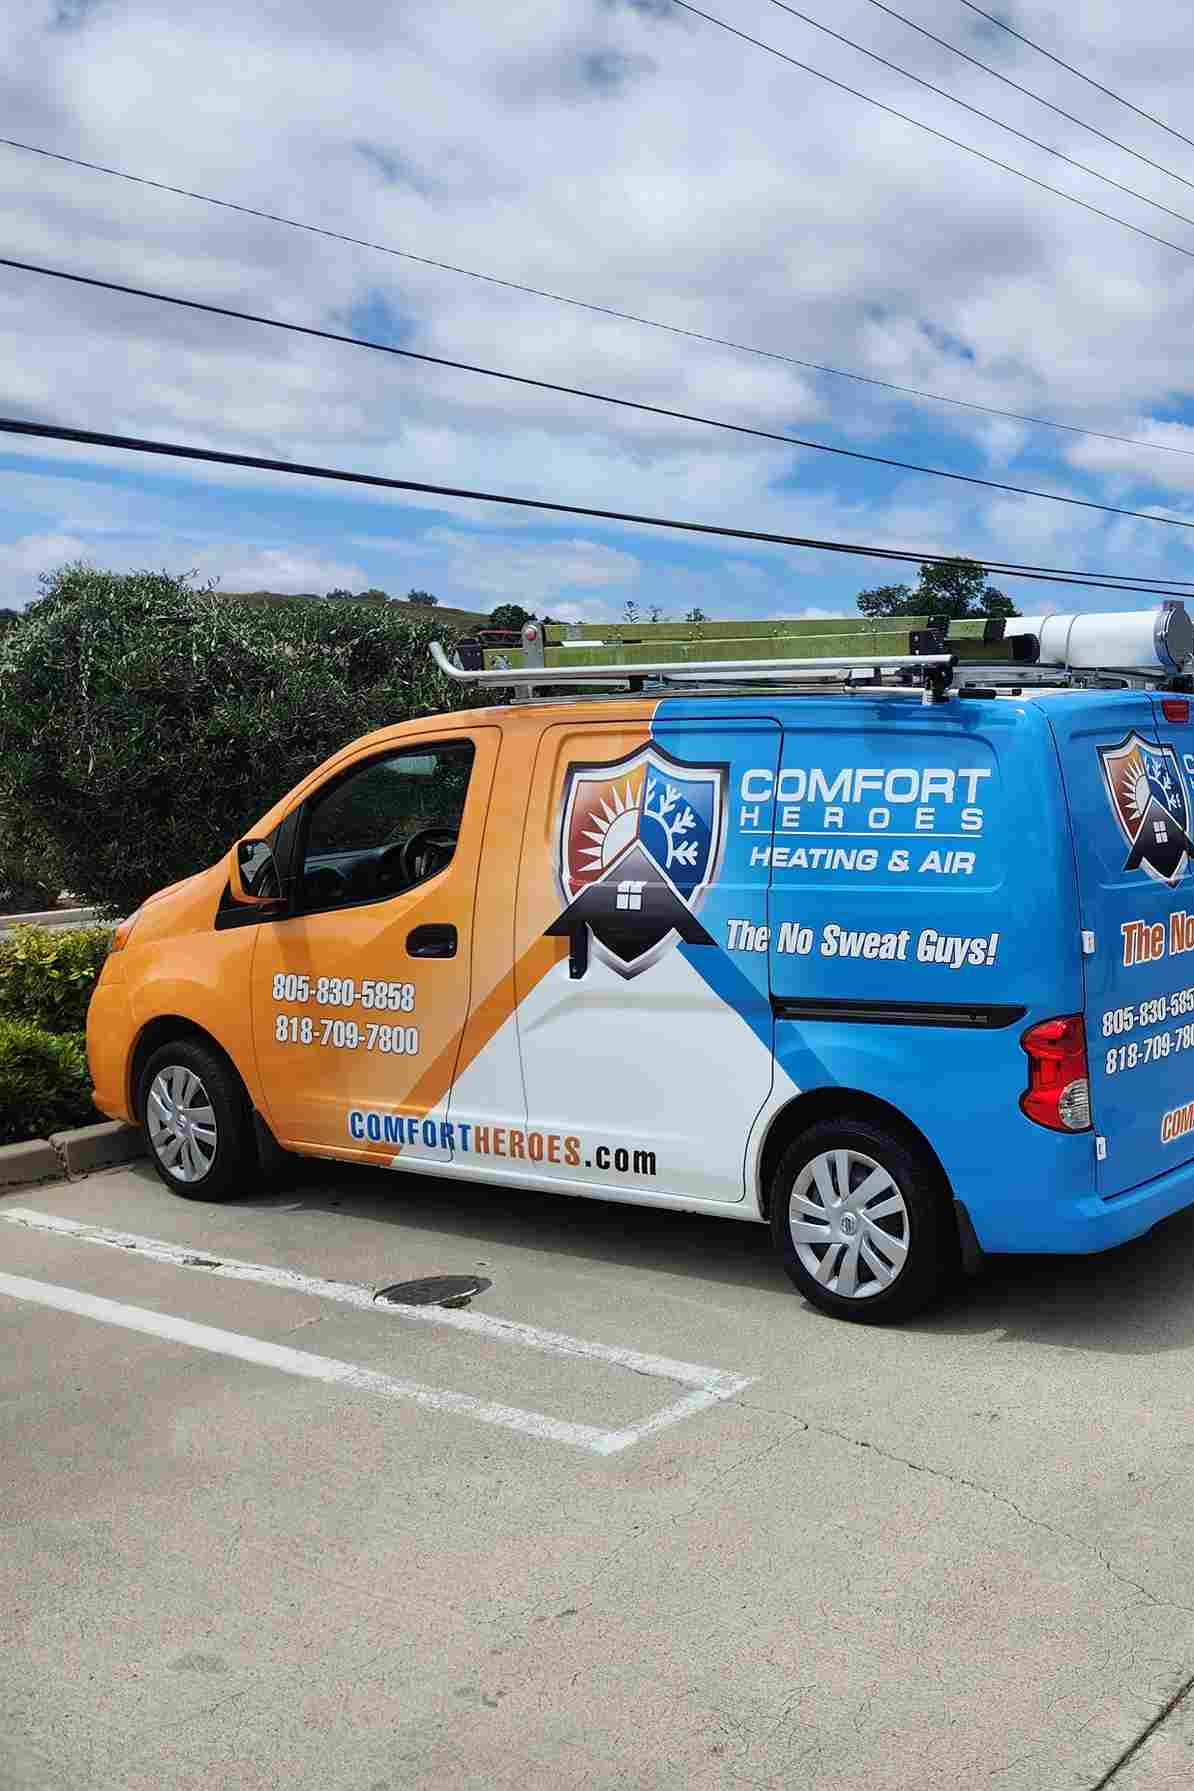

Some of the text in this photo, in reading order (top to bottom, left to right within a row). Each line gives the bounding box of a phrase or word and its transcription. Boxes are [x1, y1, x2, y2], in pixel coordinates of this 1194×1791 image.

[740, 768, 992, 804] COMFORT
[739, 805, 984, 831] HEROES
[749, 847, 977, 875] HEATING & AIR
[726, 919, 1001, 970] The No Sweat Guys!
[1120, 919, 1166, 968] The
[272, 972, 416, 1013] 805-830-5858
[275, 1014, 419, 1056] 818-709-7800
[349, 1111, 657, 1176] COMFORTHEROES.com
